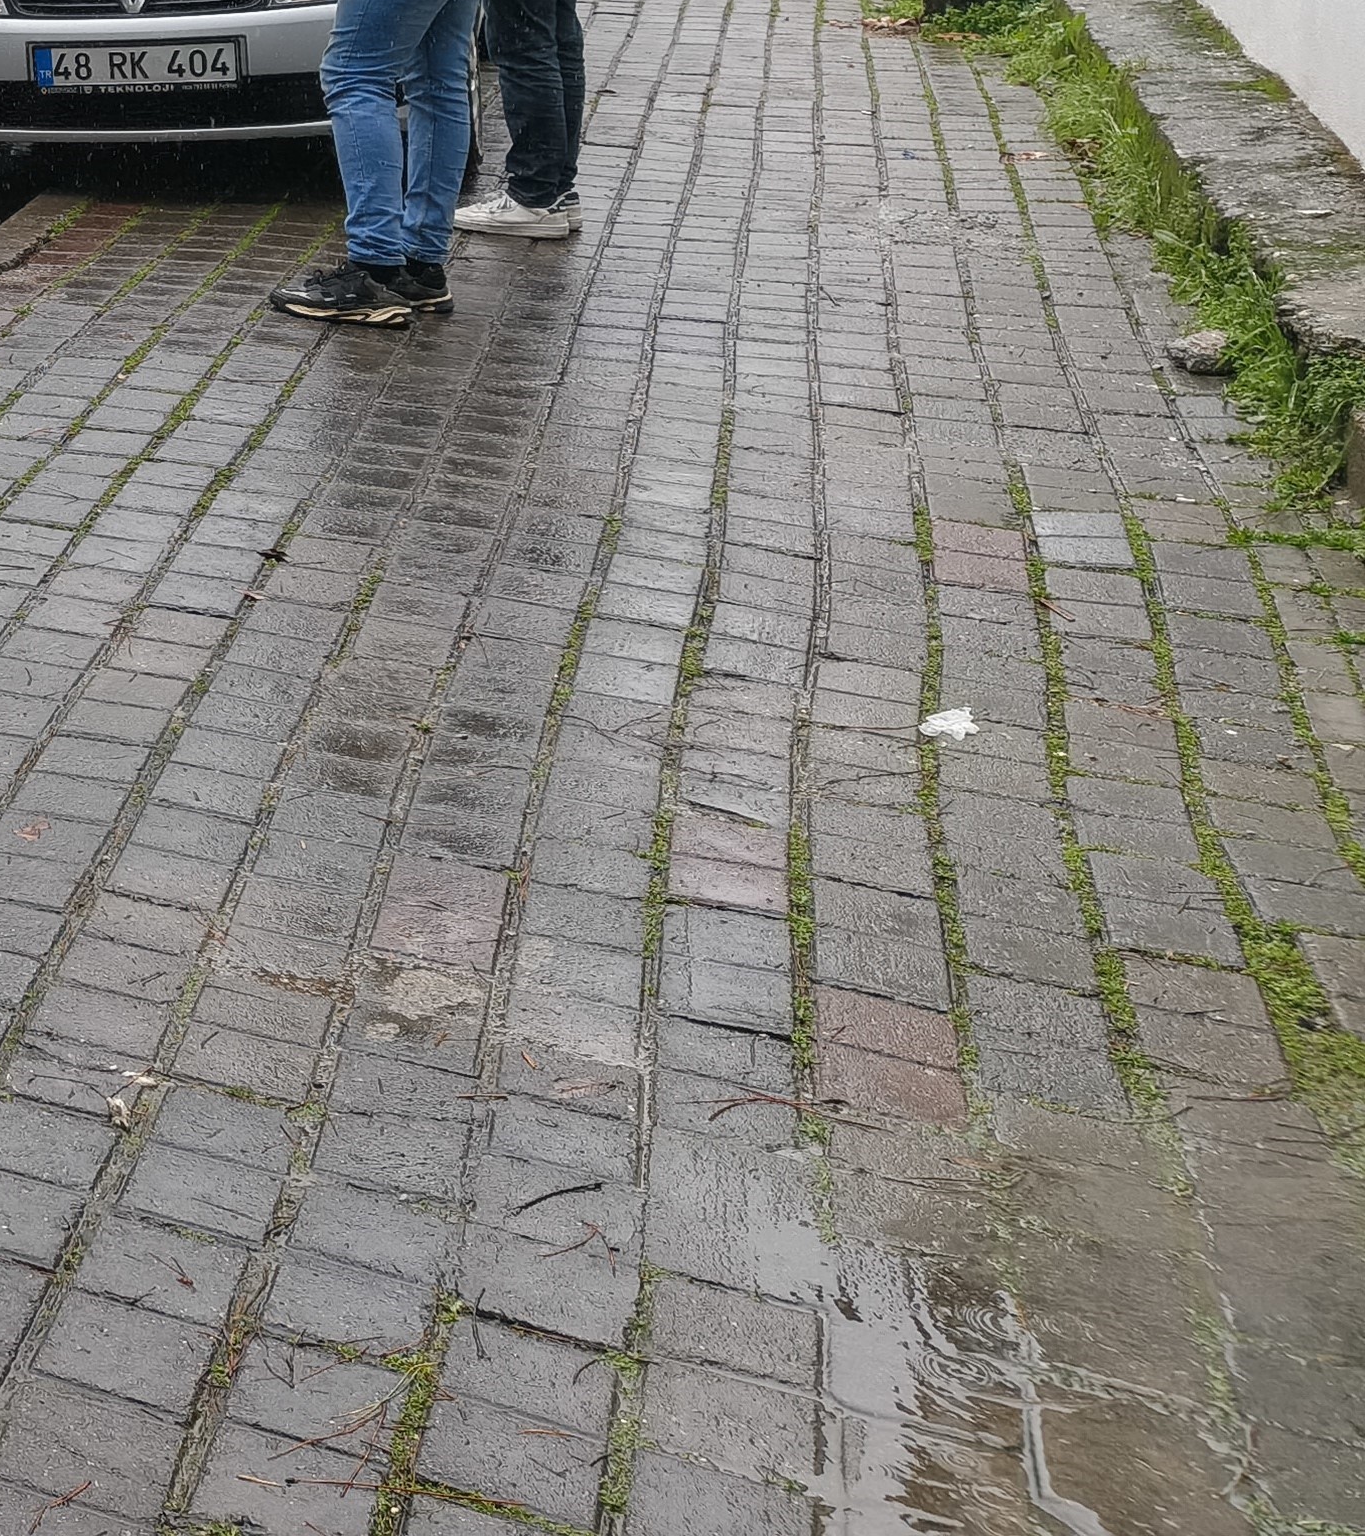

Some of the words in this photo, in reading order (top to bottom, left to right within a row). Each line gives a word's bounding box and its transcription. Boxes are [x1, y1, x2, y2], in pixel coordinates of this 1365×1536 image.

[39, 70, 52, 79] TR
[54, 53, 92, 80] 48
[108, 51, 149, 79] RK
[167, 48, 230, 77] 404
